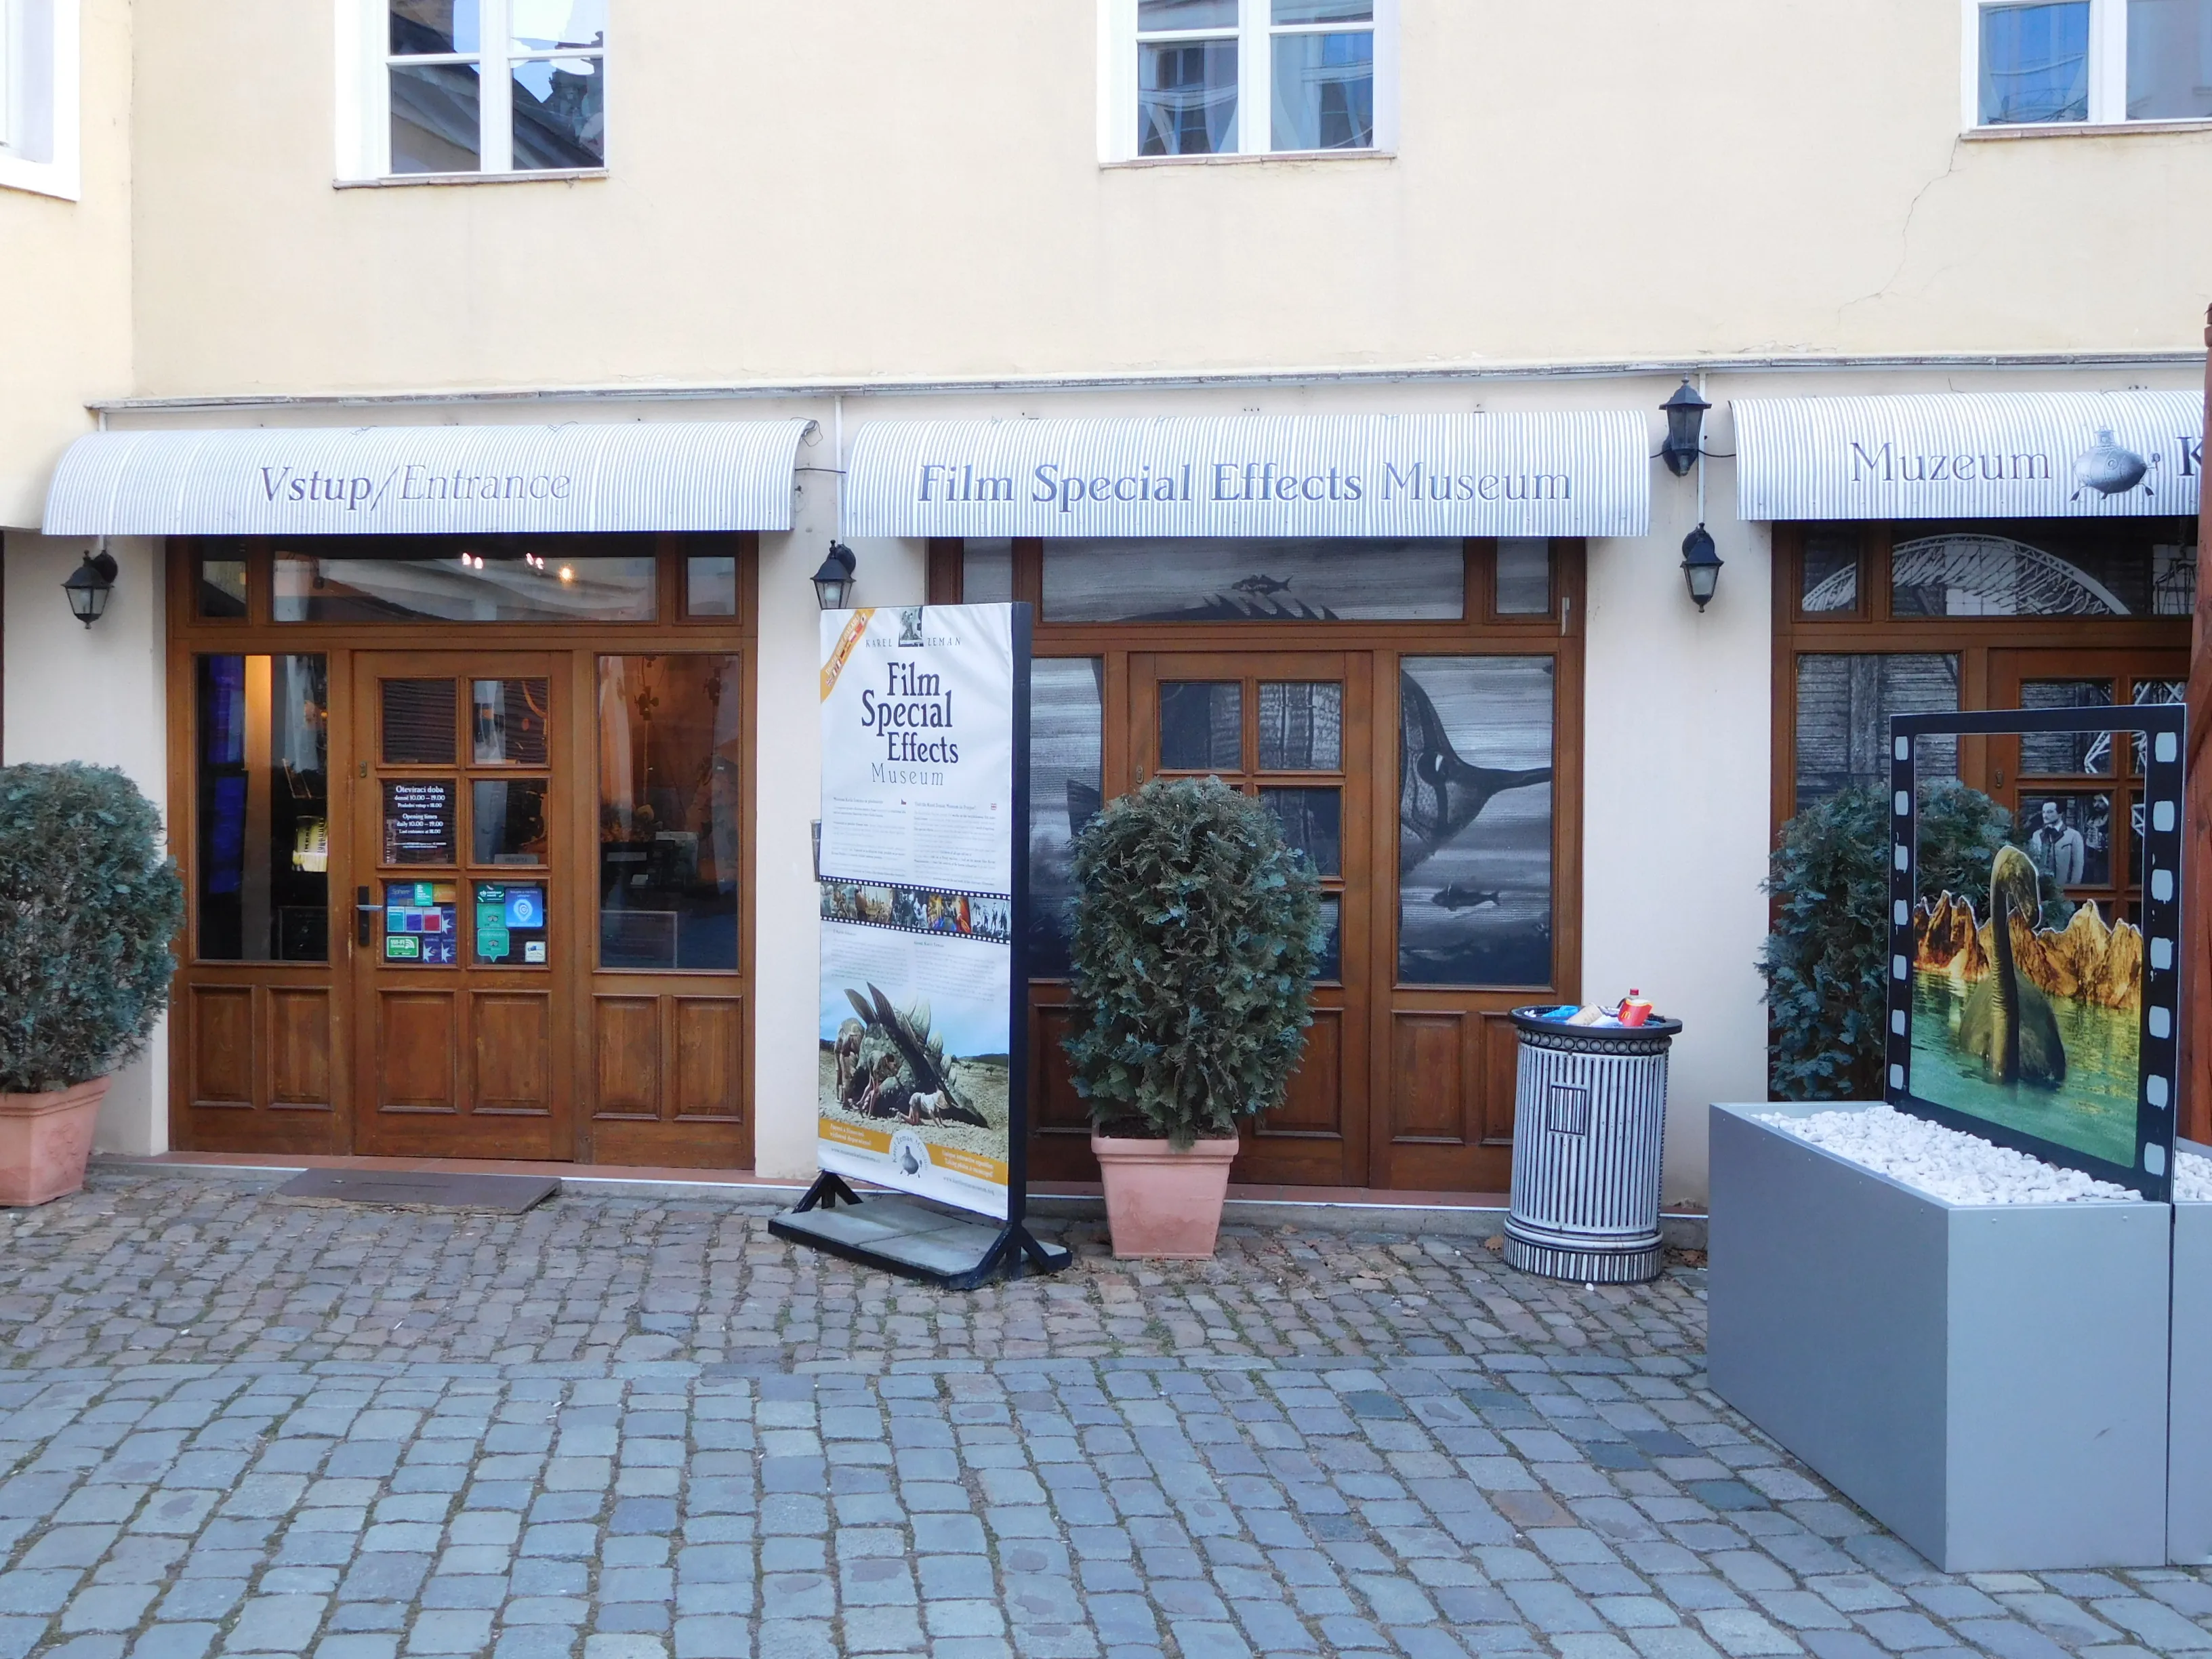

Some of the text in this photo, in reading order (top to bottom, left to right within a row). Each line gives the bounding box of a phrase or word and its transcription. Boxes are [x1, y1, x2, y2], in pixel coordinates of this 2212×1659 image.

[1849, 442, 2052, 482] Muzeum
[918, 461, 1572, 512] Film Special Effects Museum
[865, 637, 961, 648] KAREL ZEMAN
[886, 661, 941, 696] Film
[861, 689, 953, 737] Special
[886, 731, 959, 764] Effects
[871, 762, 943, 786] Museum
[896, 1136, 914, 1145] Zeman
